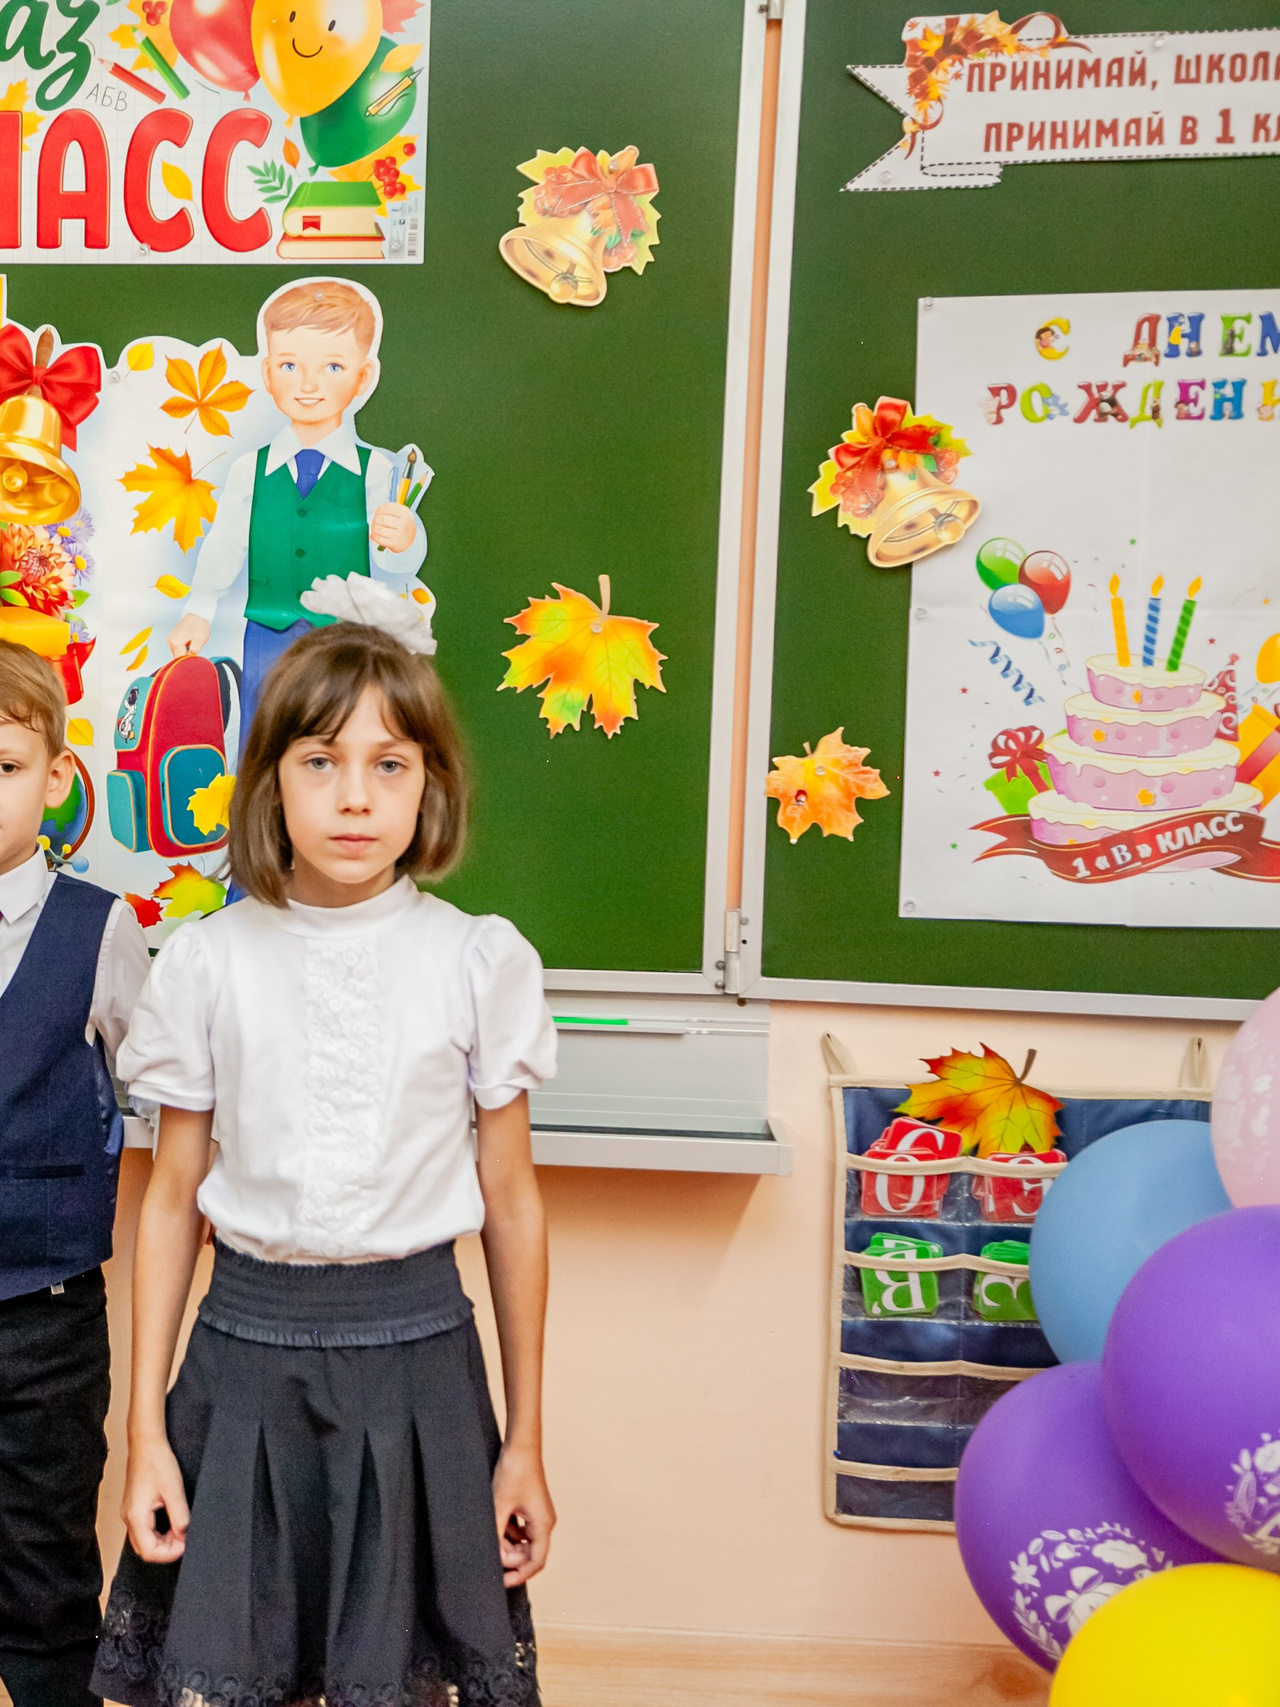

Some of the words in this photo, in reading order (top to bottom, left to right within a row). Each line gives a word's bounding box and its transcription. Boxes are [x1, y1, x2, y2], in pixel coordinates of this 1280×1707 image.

[966, 51, 1158, 93] ПРИНИМАЙ,
[85, 82, 128, 112] АБВ
[983, 111, 1164, 153] ПРИНИМАЙ
[1179, 115, 1199, 145] В
[1216, 108, 1235, 144] 1
[1035, 316, 1071, 361] С
[1072, 857, 1091, 879] 1
[1155, 812, 1244, 854] КЛАСС
